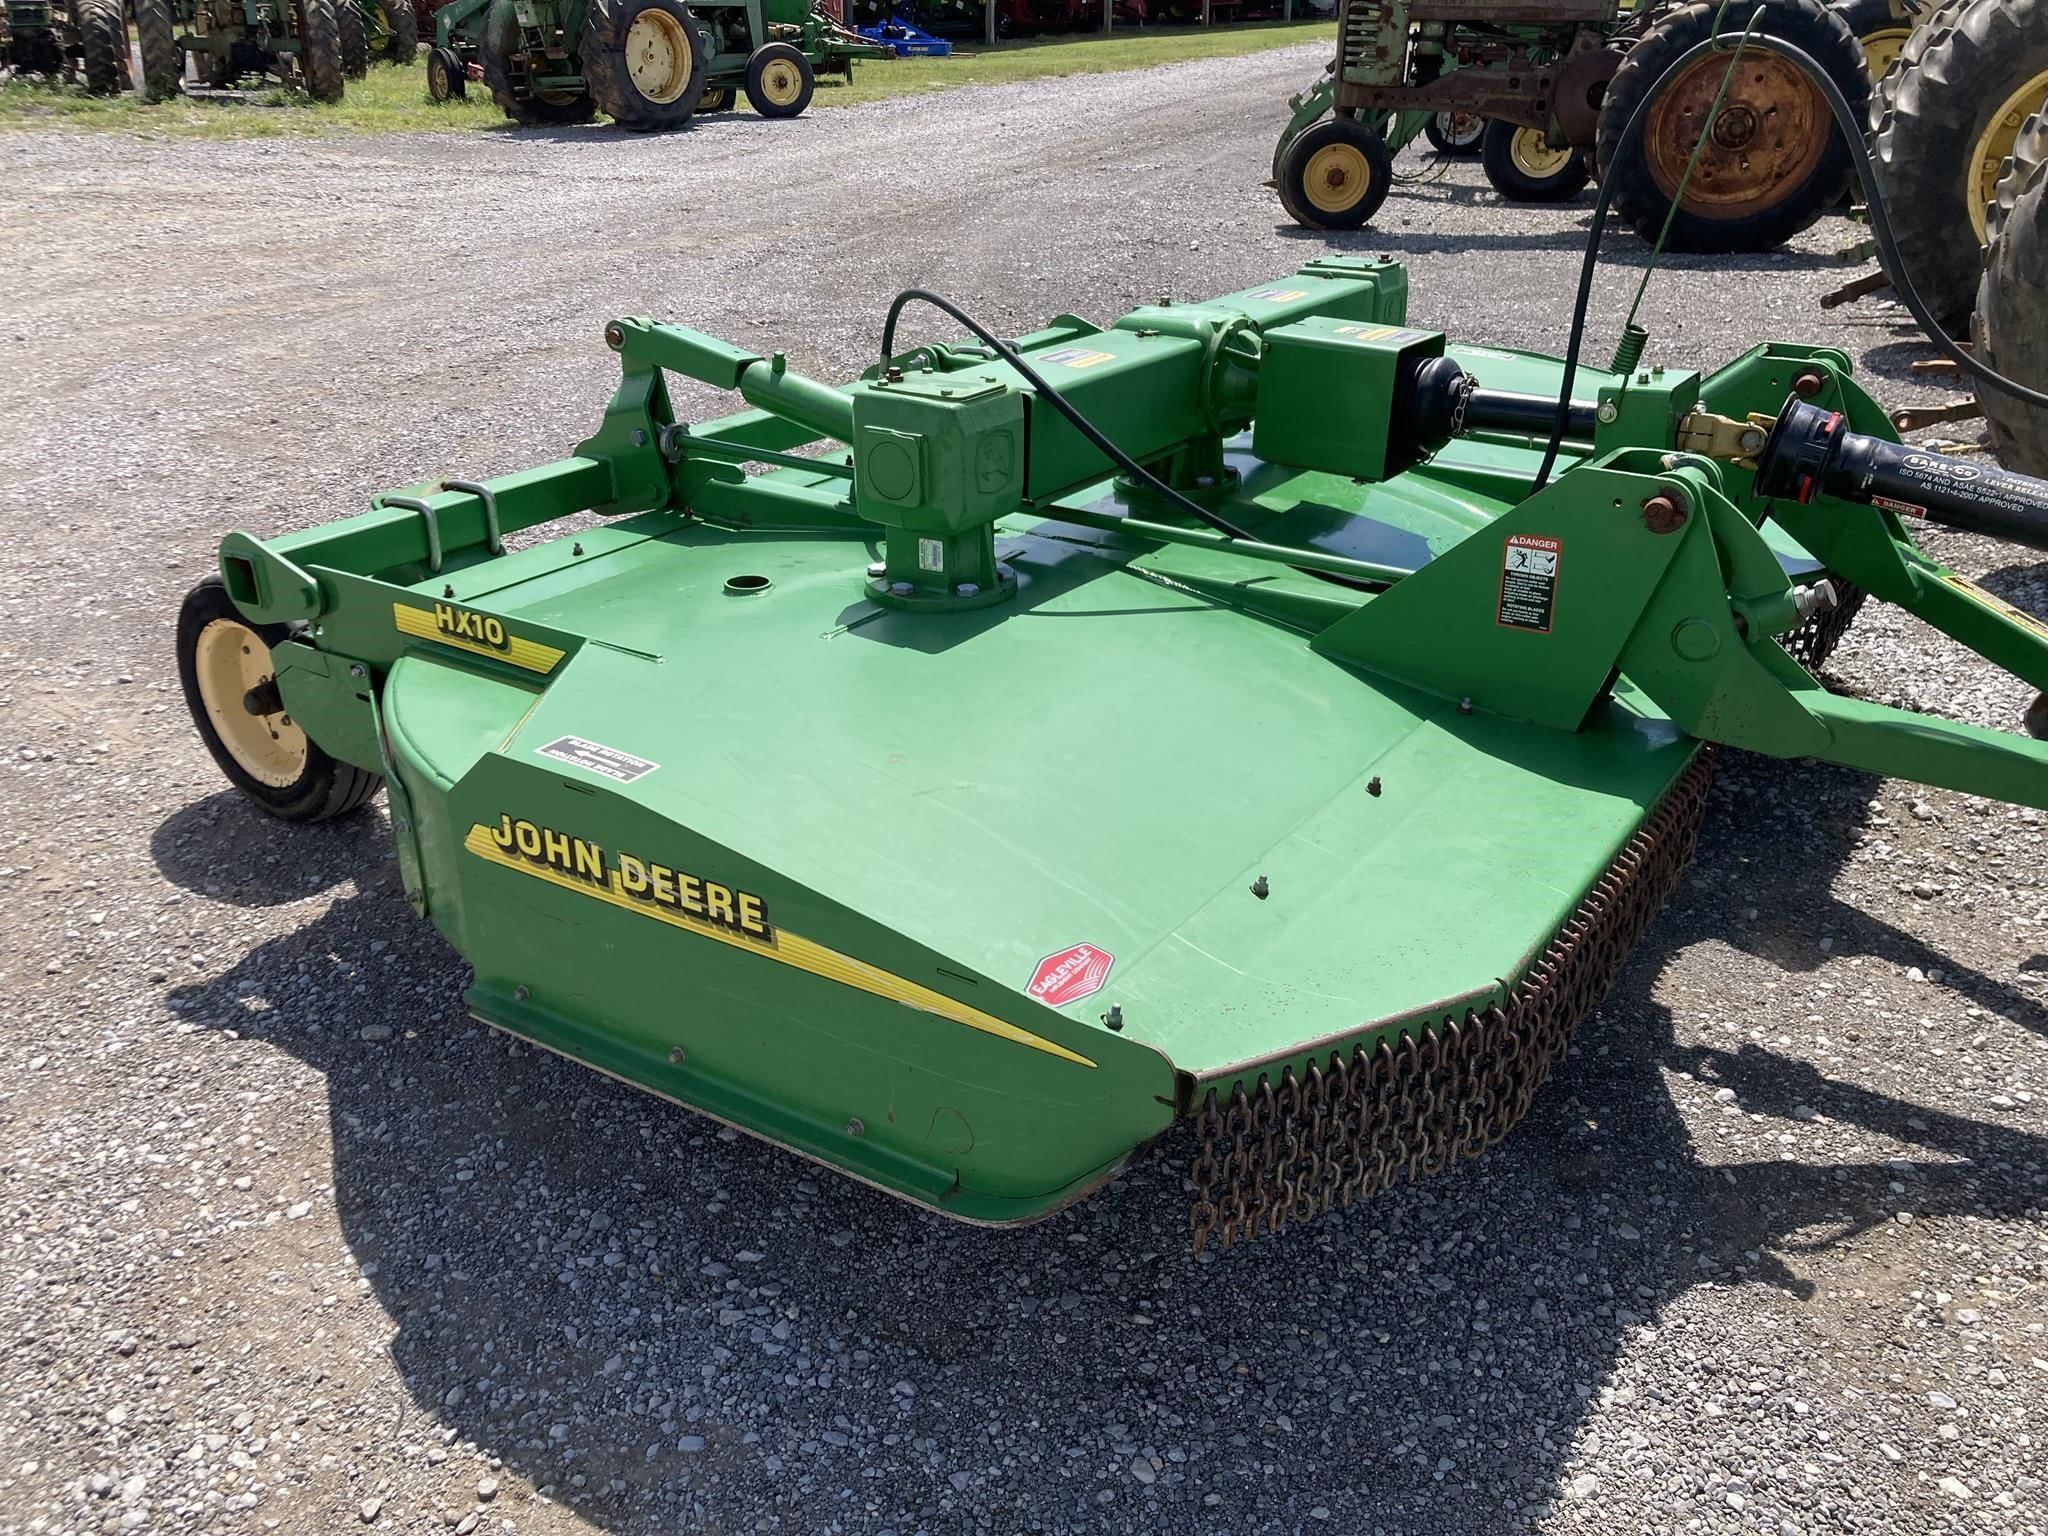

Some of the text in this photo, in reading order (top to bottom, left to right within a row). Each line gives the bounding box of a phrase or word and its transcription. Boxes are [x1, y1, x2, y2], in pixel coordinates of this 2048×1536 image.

[1899, 467, 1912, 478] ISO
[1934, 475, 1951, 486] AND
[1953, 480, 1976, 492] ASAE
[2003, 493, 2048, 510] APPROVED
[1920, 482, 1932, 491] AS
[1978, 496, 2024, 512] APPROVED
[1984, 478, 2014, 490] LEVER
[1883, 500, 1917, 514] DANGER
[1519, 537, 1557, 549] DANGER
[434, 602, 509, 651] HX10
[568, 739, 646, 768] BLADE ROTATION
[490, 812, 771, 940] JOHN DEERE
[1031, 947, 1093, 994] EAGLEVILLE
